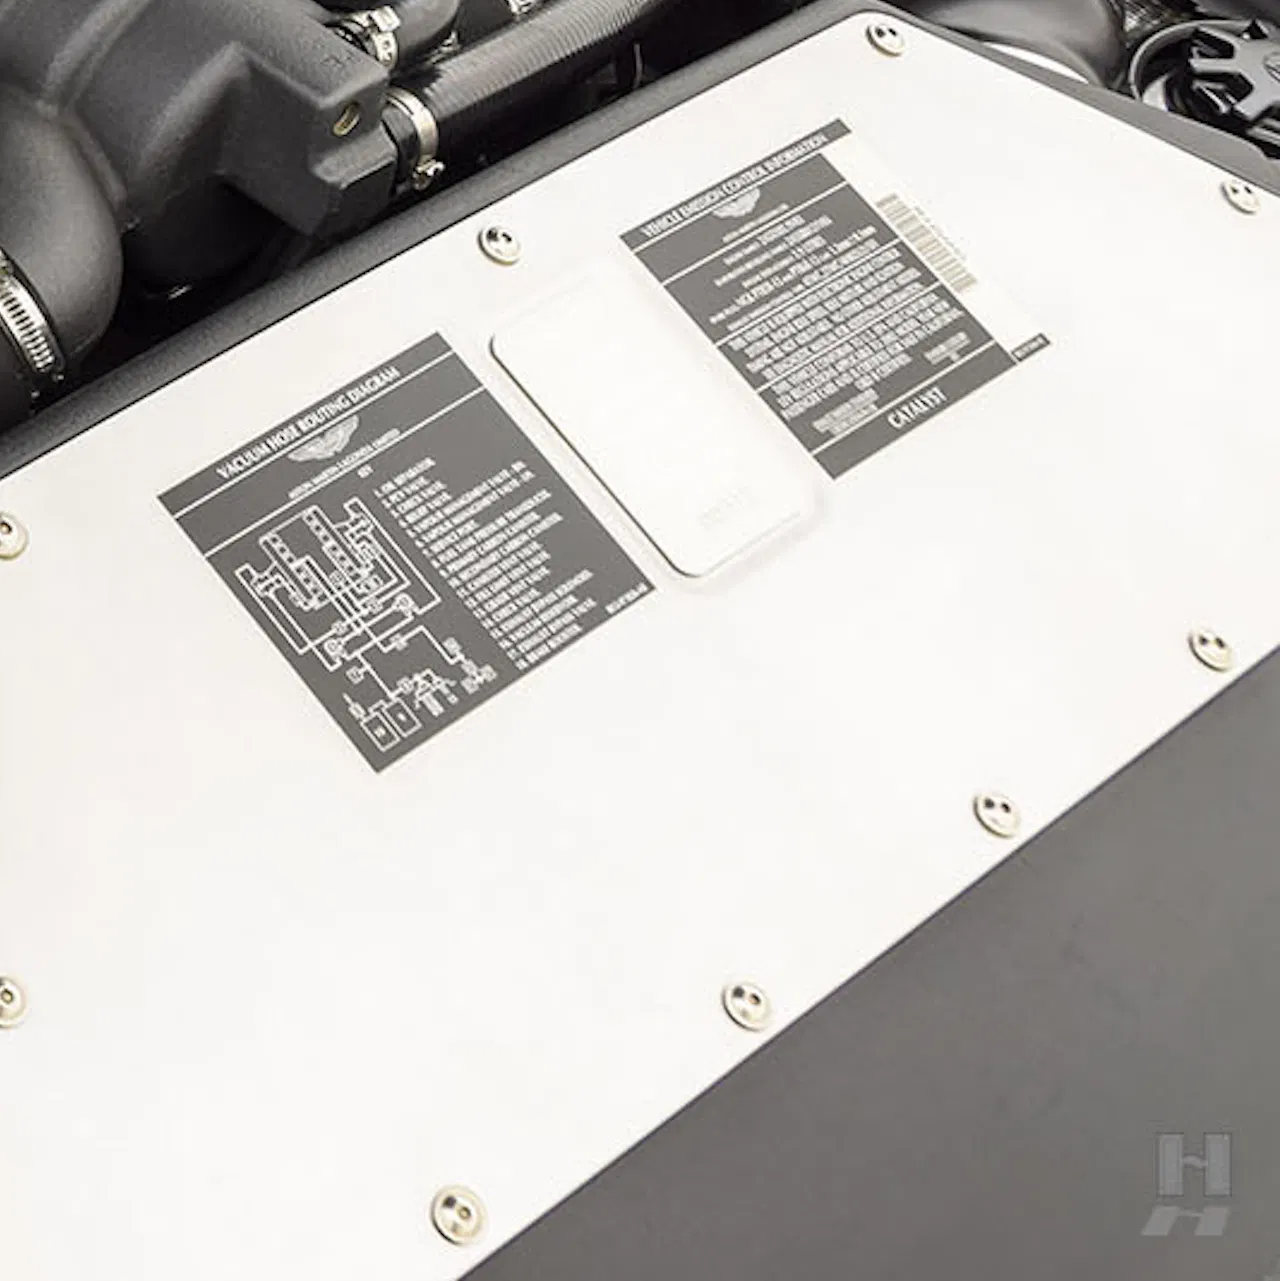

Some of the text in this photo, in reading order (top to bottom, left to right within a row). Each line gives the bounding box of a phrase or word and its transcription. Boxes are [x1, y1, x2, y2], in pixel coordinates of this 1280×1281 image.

[216, 443, 269, 479] VACUUM
[267, 425, 299, 449] HOSE
[297, 396, 349, 431] ROUTING
[347, 366, 399, 401] DIAGRAM
[887, 387, 946, 429] CATALYST
